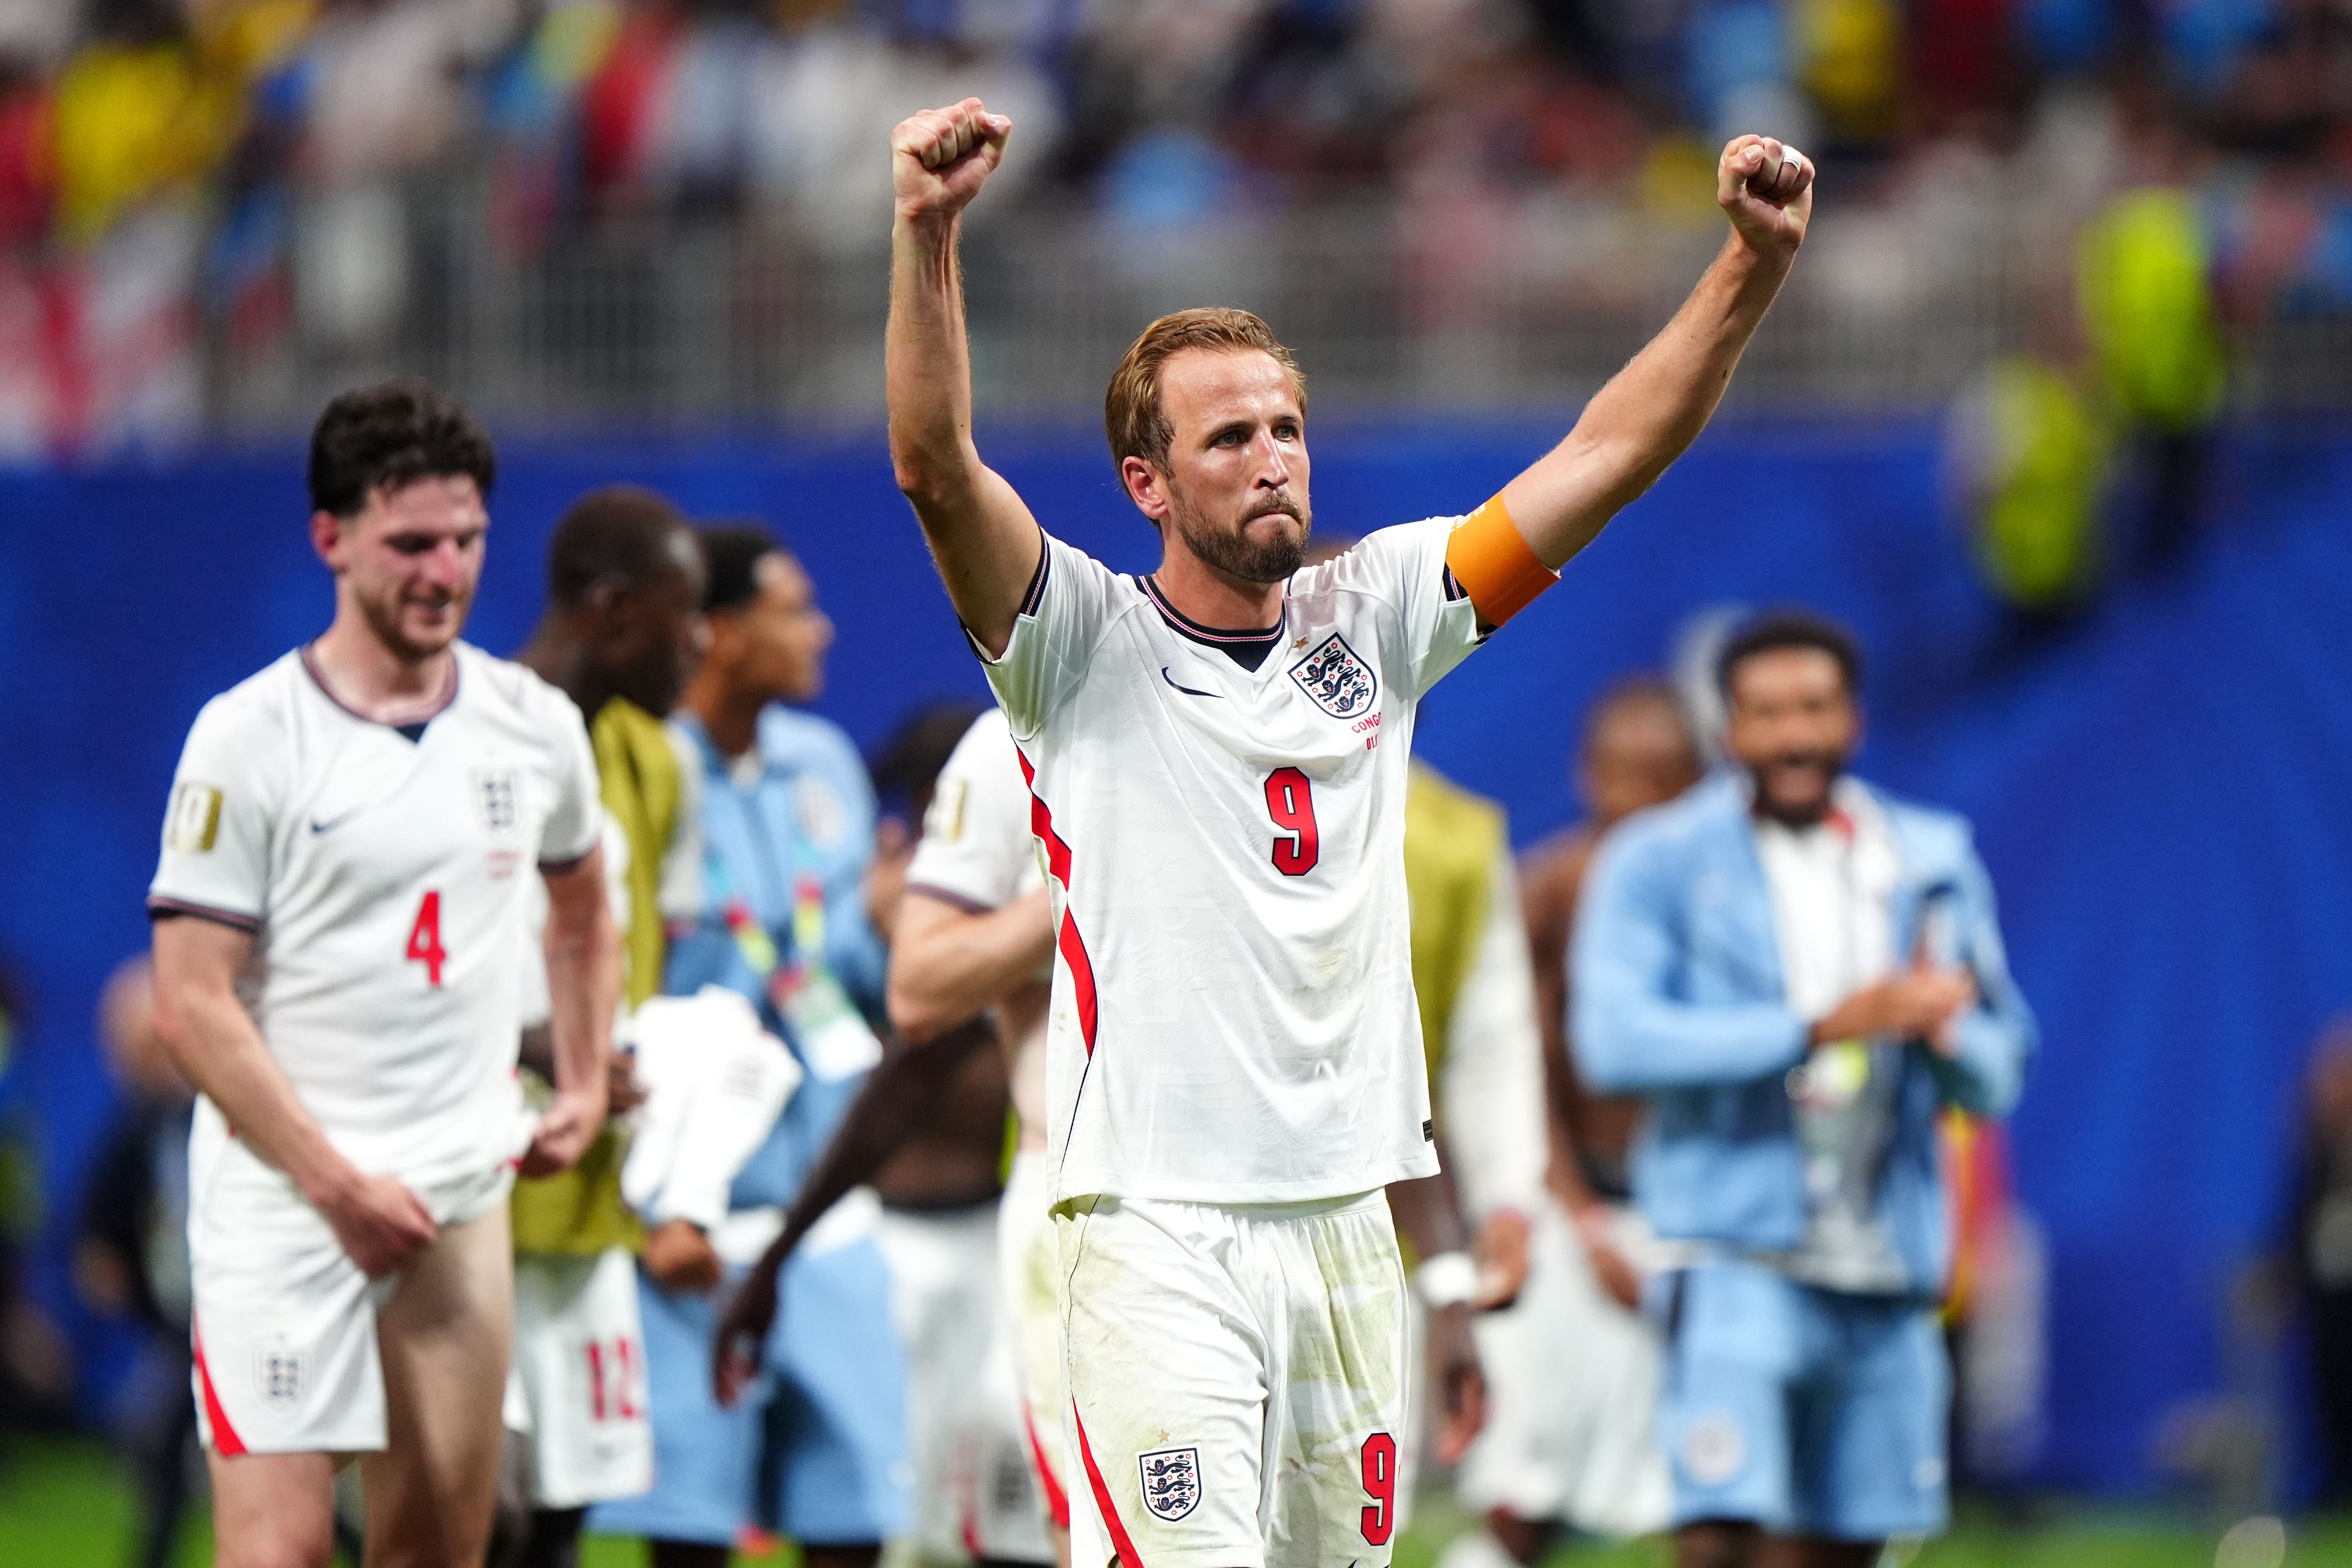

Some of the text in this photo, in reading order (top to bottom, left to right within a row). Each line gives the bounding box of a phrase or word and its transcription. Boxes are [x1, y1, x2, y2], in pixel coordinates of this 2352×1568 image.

[1264, 766, 1319, 876] 9
[405, 891, 446, 988] 4
[1361, 1433, 1396, 1546] 9
